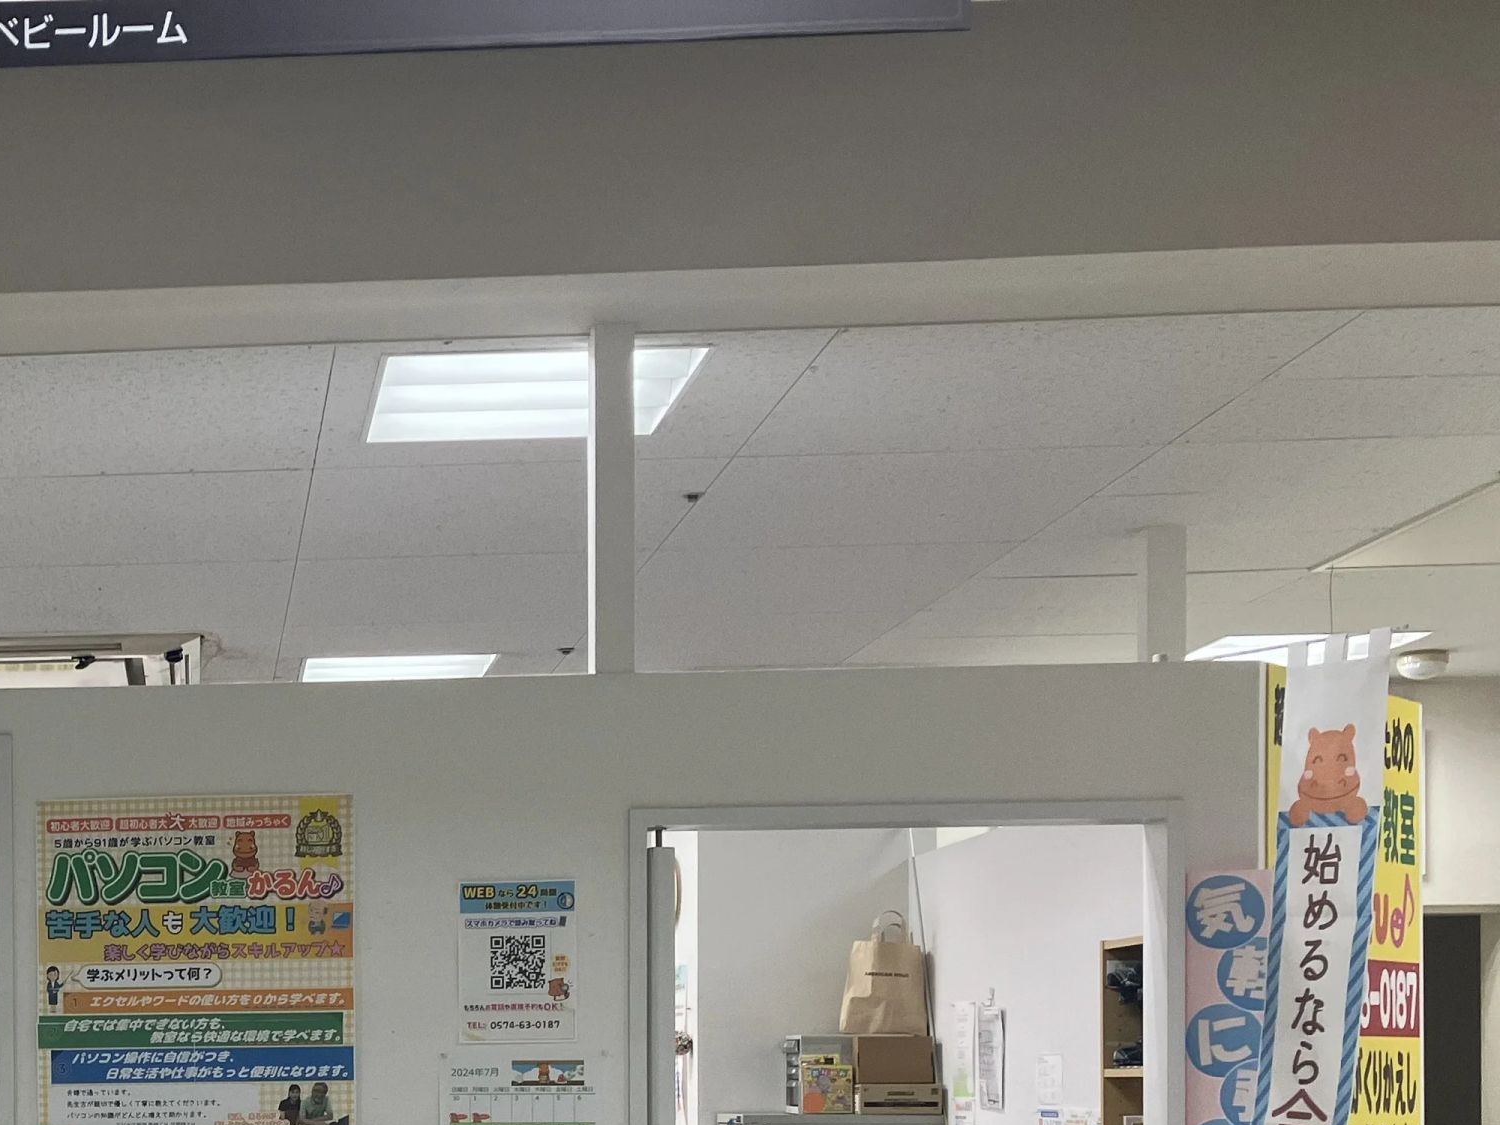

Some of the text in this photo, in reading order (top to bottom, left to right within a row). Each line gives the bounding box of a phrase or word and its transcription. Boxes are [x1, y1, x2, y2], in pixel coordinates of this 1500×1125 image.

[50, 819, 111, 832] 初心者大歓迎
[54, 835, 216, 849] 5歳から91歳が学ぶパソコン教室
[490, 1020, 560, 1030] 0574-63-0187
[451, 1067, 499, 1078] 2024年7月
